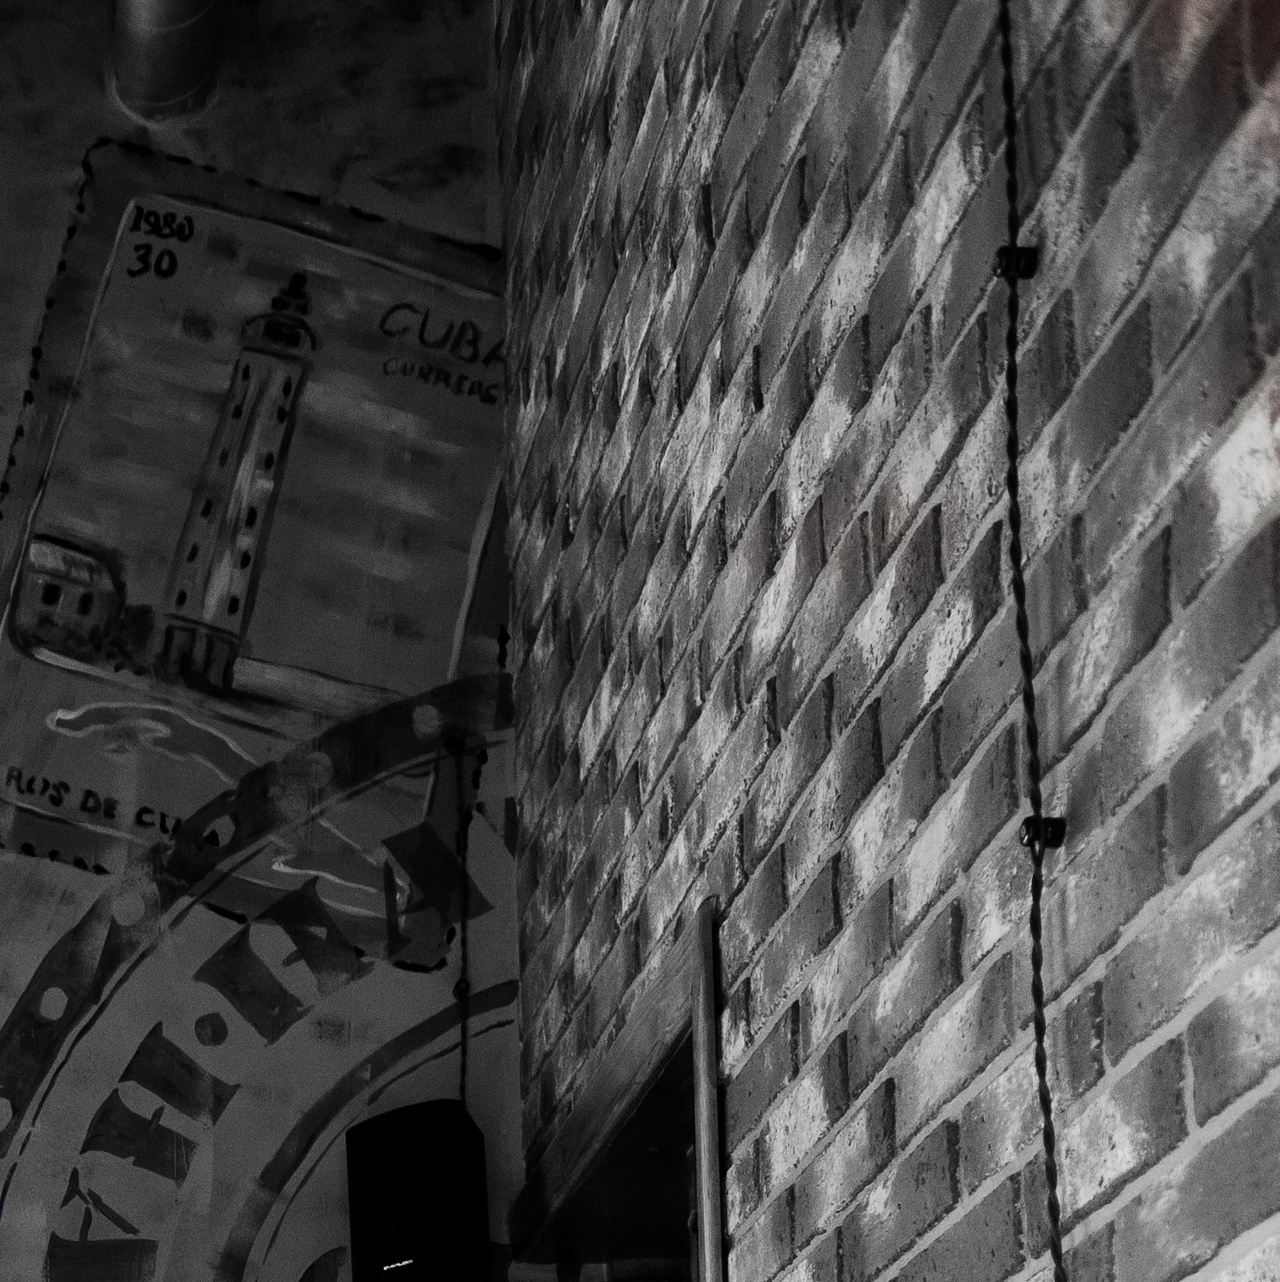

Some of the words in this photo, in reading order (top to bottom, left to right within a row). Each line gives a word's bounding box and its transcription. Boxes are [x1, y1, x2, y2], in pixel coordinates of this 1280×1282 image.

[129, 205, 194, 242] 1980
[127, 243, 178, 279] 30
[380, 302, 507, 367] CUBA
[80, 789, 118, 819] DE
